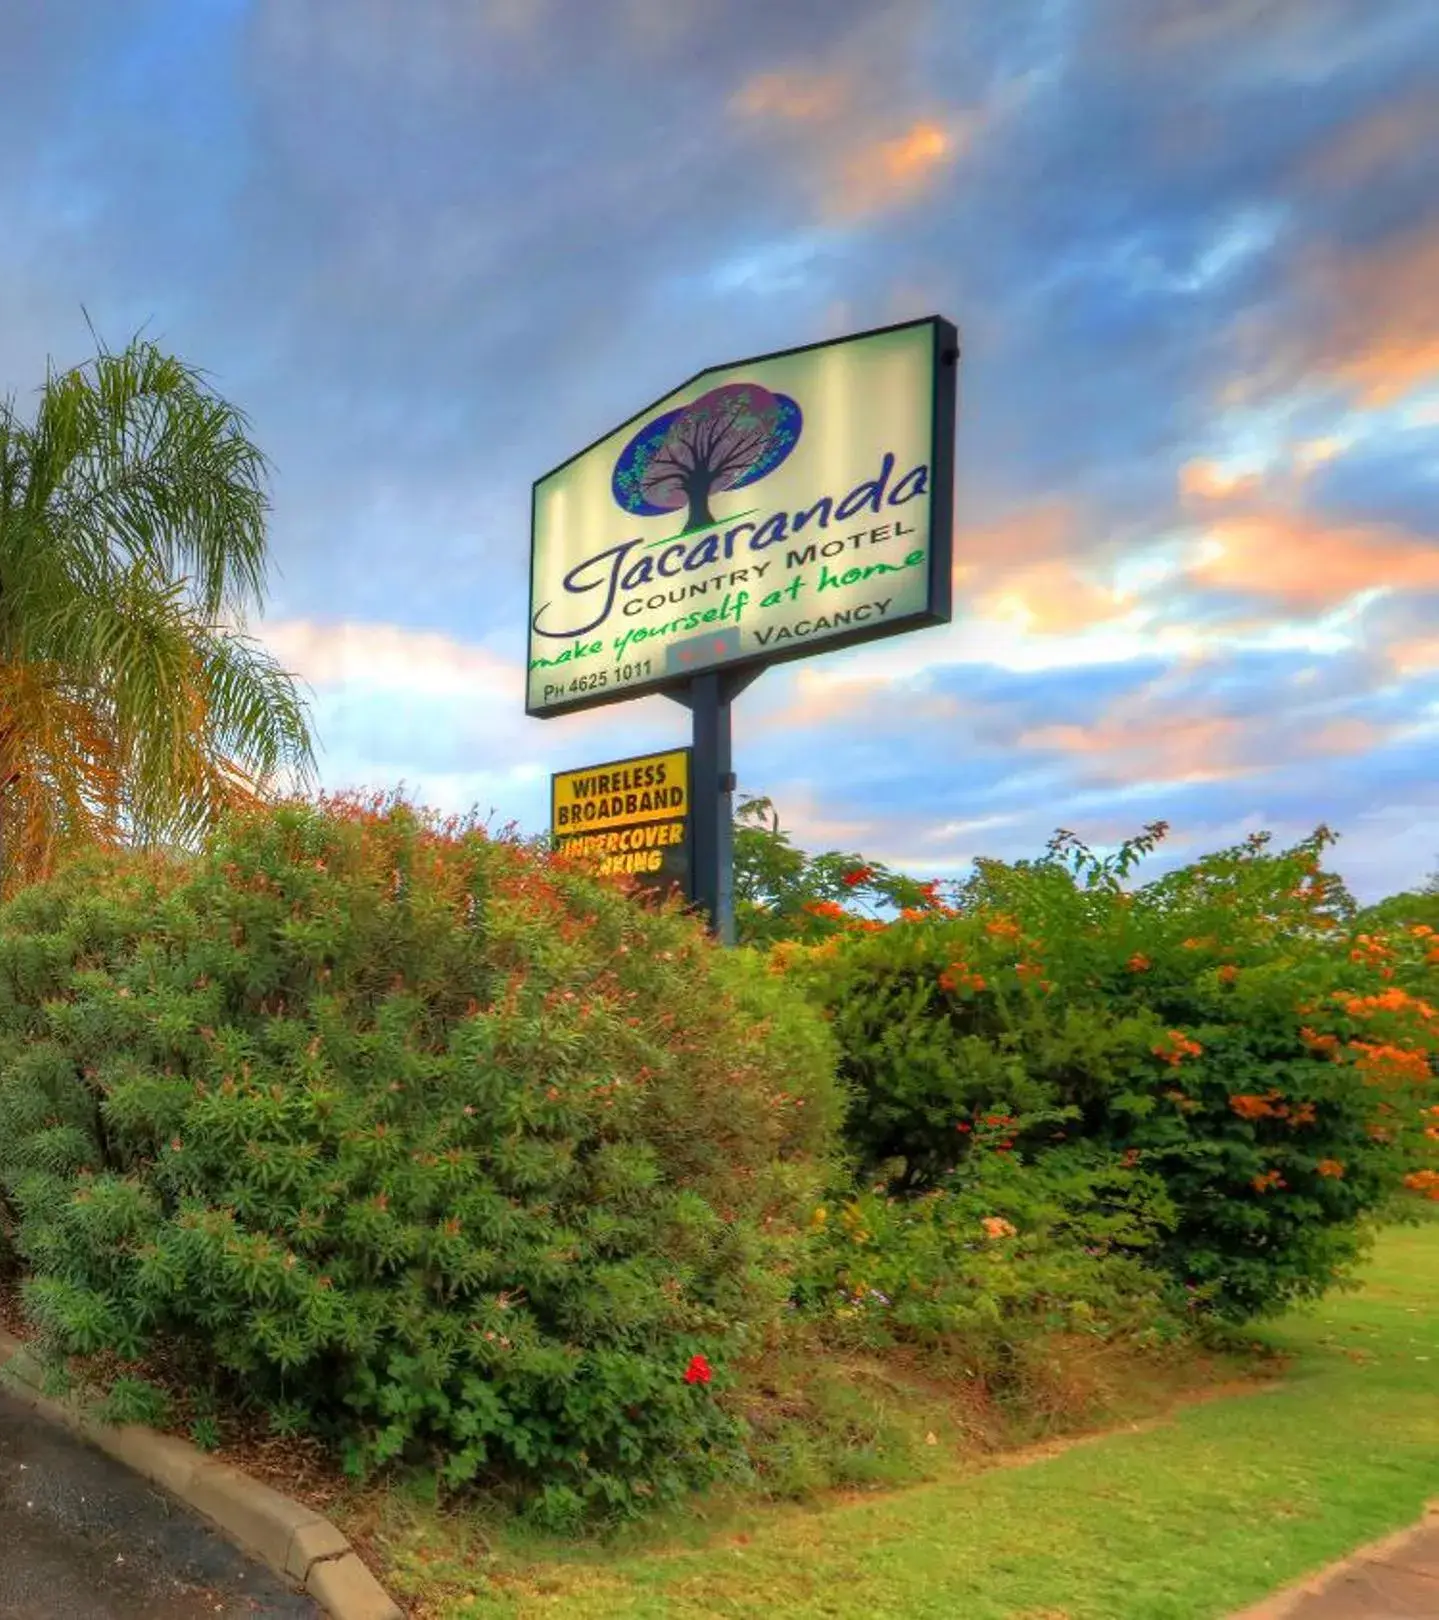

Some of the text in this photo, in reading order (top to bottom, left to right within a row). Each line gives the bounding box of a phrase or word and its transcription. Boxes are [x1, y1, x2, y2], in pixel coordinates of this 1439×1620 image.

[532, 451, 928, 638] Jacaranda
[622, 521, 916, 617] COUNTRY MOTEL
[529, 639, 604, 671] make
[612, 590, 750, 662] yourself
[759, 575, 806, 608] at
[816, 549, 926, 592] home
[753, 598, 893, 647] VACANCY
[568, 671, 608, 694] 4625
[614, 660, 652, 684] 1011
[572, 762, 668, 799] WIRELESS
[557, 785, 684, 826] BROADBAND
